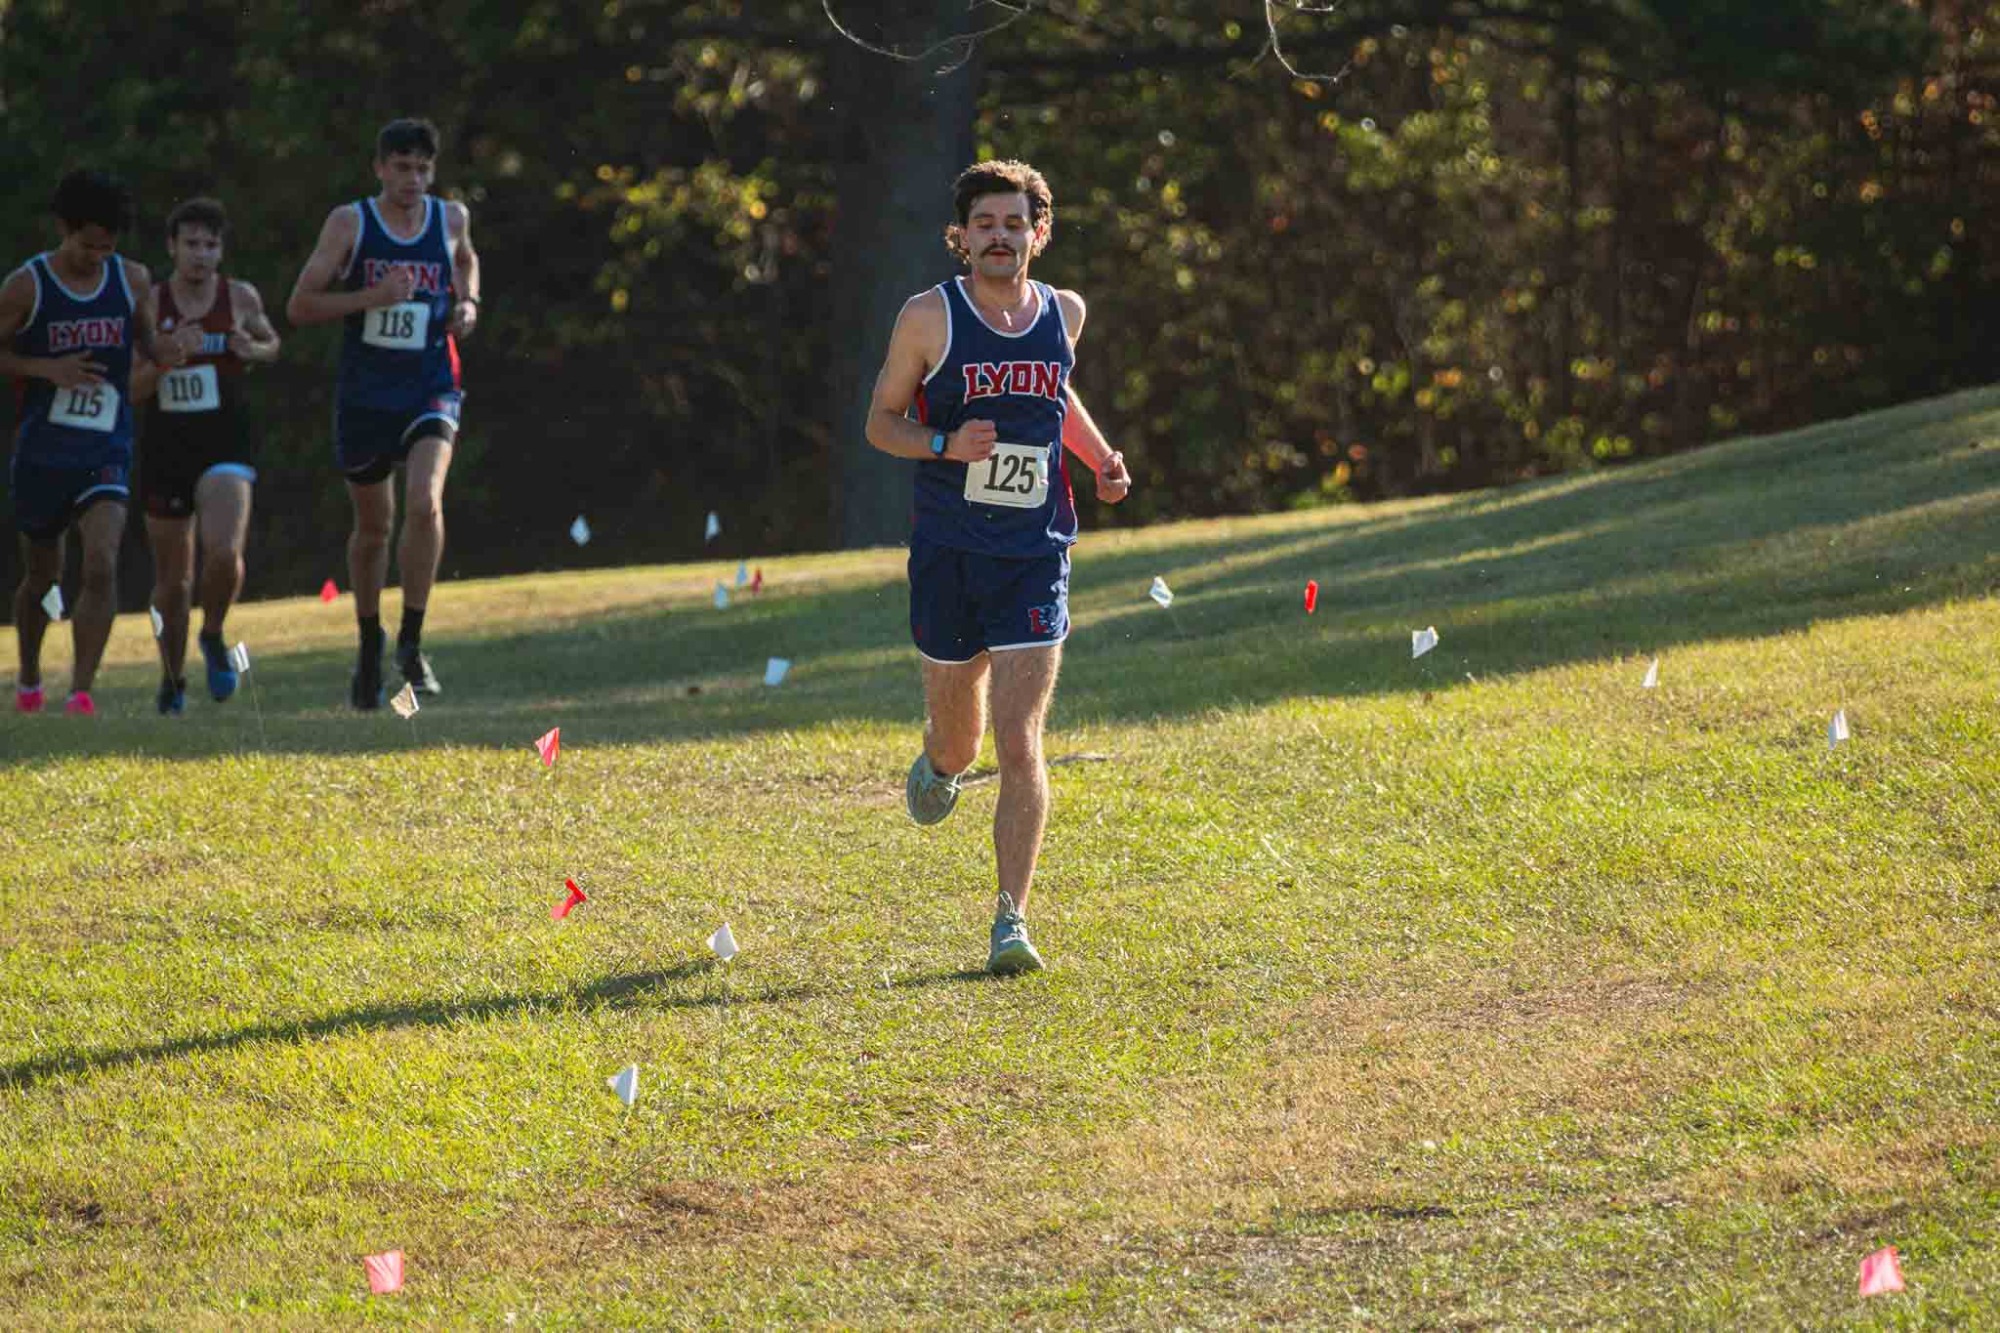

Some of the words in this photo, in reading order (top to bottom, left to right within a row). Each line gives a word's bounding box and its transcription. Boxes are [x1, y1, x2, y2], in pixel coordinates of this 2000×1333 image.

[46, 315, 126, 353] LYON
[378, 310, 415, 339] 118
[168, 373, 203, 402] 110
[962, 361, 1062, 402] LYON
[66, 387, 103, 417] 115
[983, 453, 1038, 495] 125
